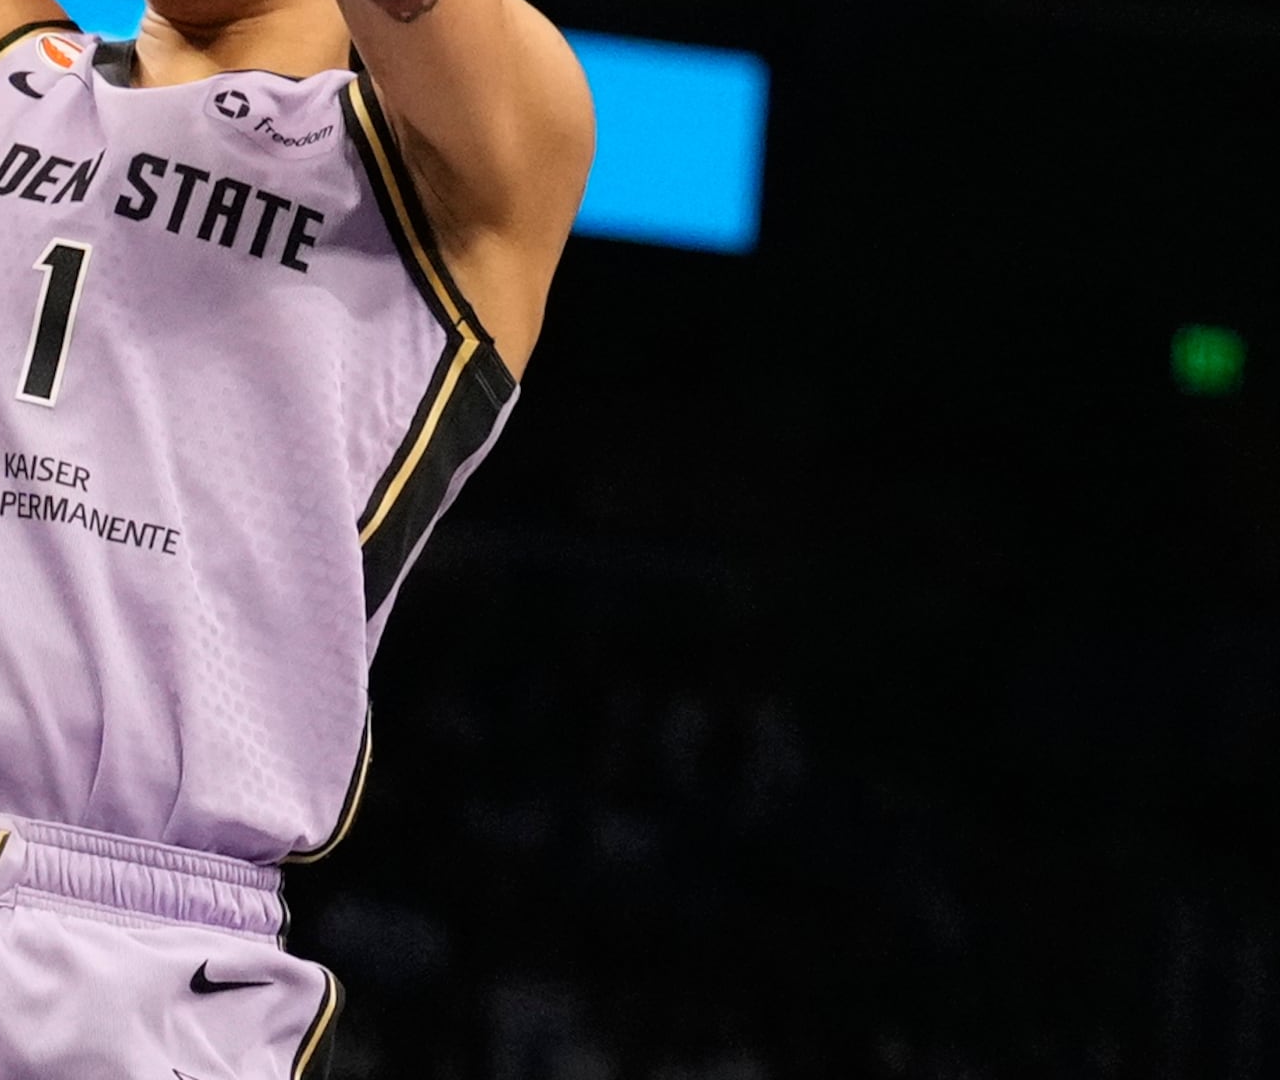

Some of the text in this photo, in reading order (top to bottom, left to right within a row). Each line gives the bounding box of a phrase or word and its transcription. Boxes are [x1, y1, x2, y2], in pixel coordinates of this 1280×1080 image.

[254, 117, 334, 147] freedom
[114, 152, 325, 274] STATE
[15, 237, 93, 408] 1
[3, 452, 91, 493] KAISER
[0, 491, 181, 557] PERMANENTE
